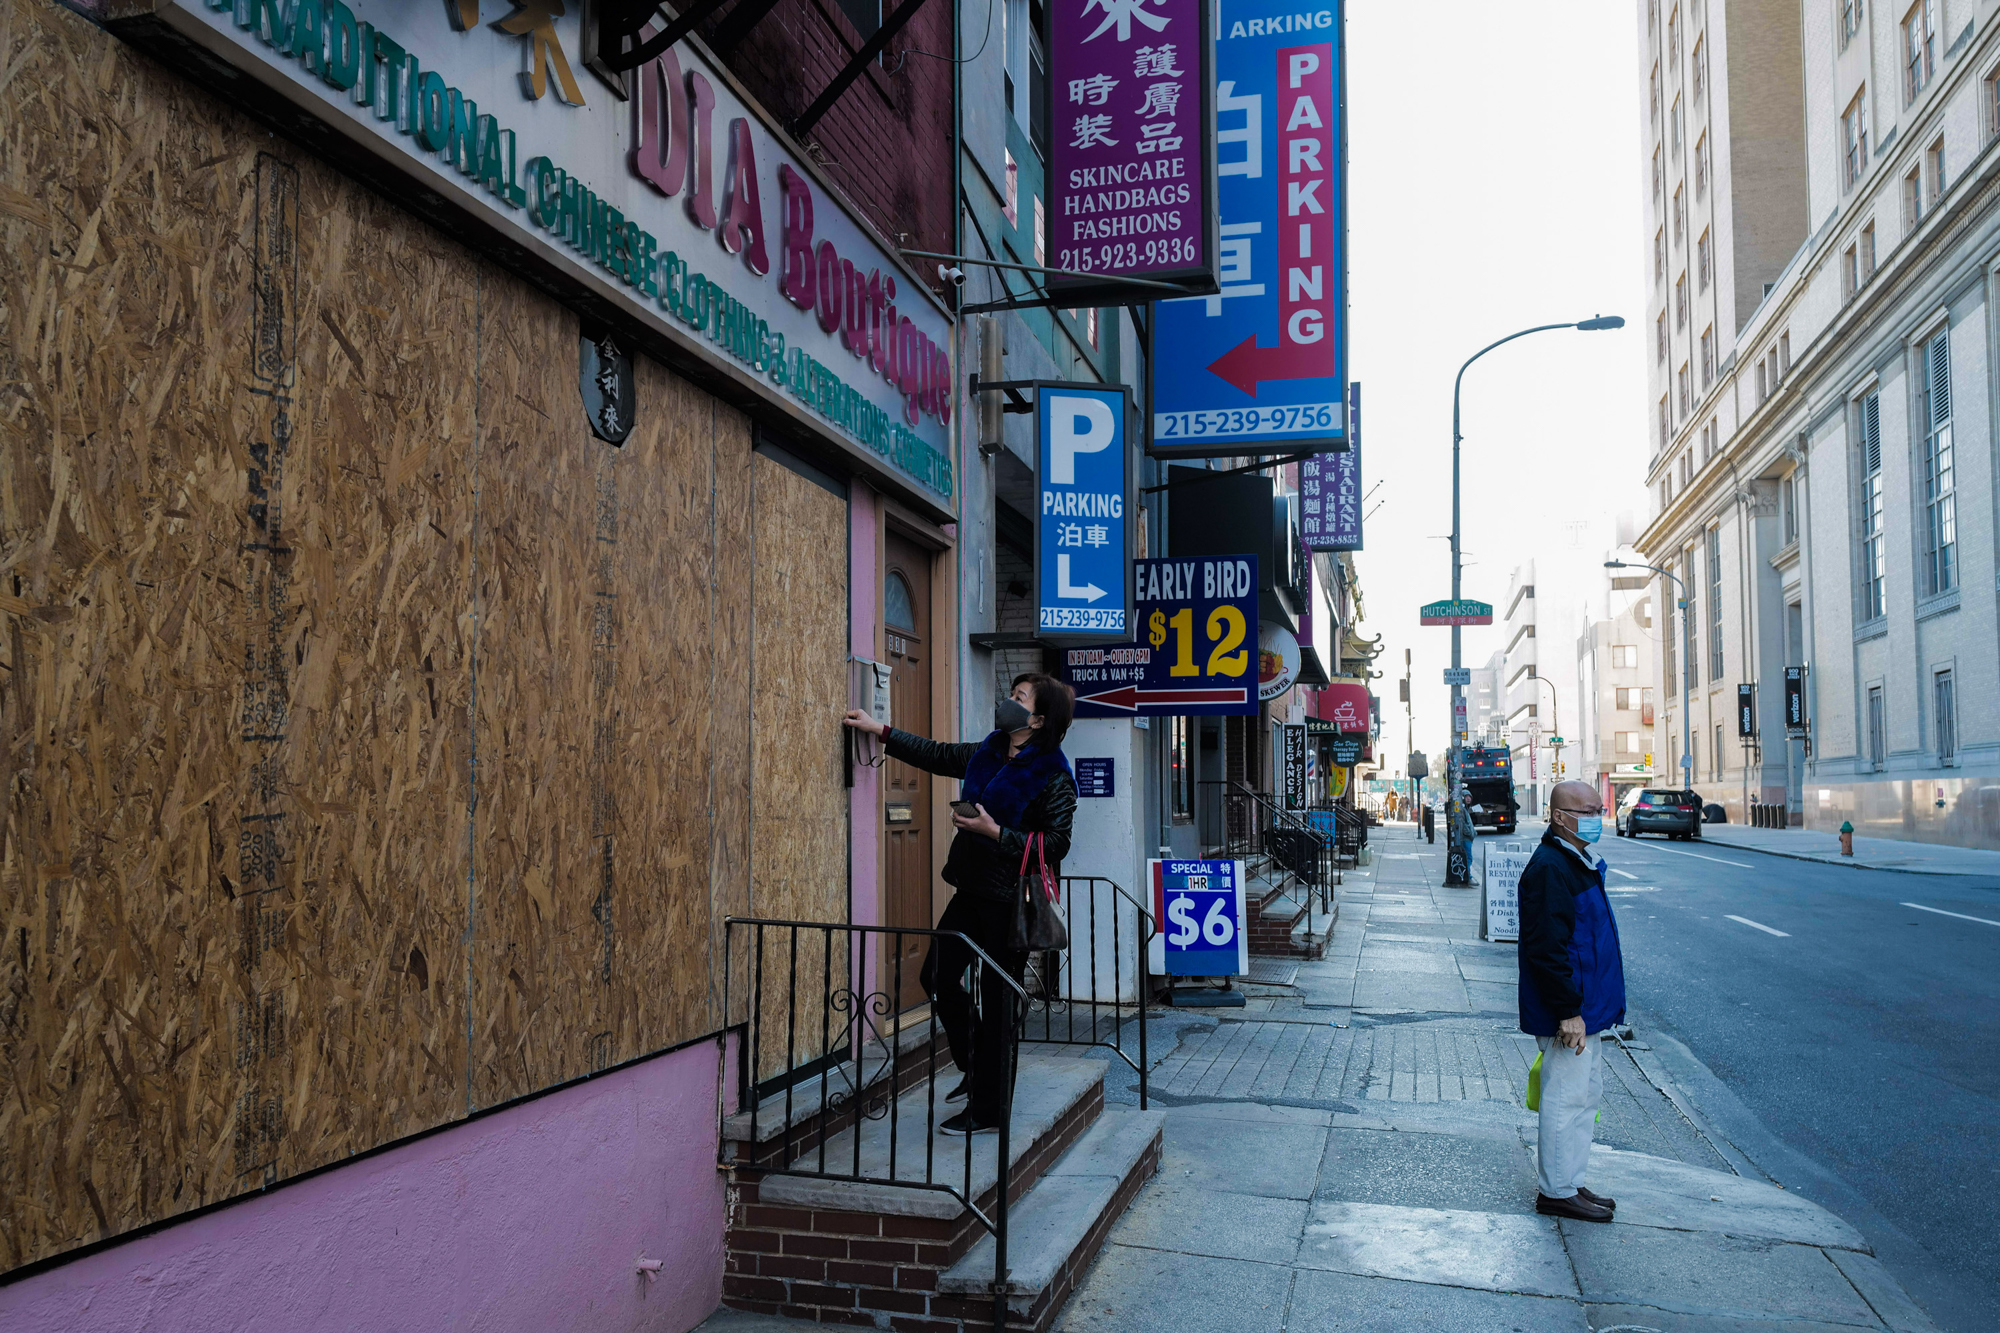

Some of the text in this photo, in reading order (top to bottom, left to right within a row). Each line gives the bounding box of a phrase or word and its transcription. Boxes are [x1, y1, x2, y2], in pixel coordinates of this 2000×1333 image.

[1068, 73, 1120, 150] 時裝
[1133, 43, 1185, 155] 護膚品
[1070, 157, 1185, 189] SKINCARE
[1064, 183, 1190, 215] HANDBAGS
[1286, 53, 1325, 345] PARKING
[204, 0, 526, 210] RADITIONAL
[524, 155, 657, 303] CHINESE
[658, 249, 769, 373] CLOTHING
[786, 346, 889, 455] ALTERATIONS
[630, 24, 770, 279] DIA
[780, 162, 952, 427] Boutique
[1073, 210, 1181, 241] FASHIONS
[1060, 235, 1196, 273] 215-923-9336
[1163, 405, 1332, 437] 215-239-9756
[1050, 395, 1115, 485] P
[1339, 440, 1356, 532] ESTAURANT
[1043, 491, 1123, 519] PARKING
[1056, 522, 1110, 548] 泊車
[1136, 560, 1251, 601] EARLY BIRD
[1041, 608, 1125, 630] 215-239-9756
[1422, 605, 1481, 617] HUTCHINSON
[1068, 650, 1076, 665] IN
[1077, 650, 1086, 665] BY
[1086, 649, 1104, 665] 10AM
[1111, 649, 1125, 664] OUT
[1125, 649, 1135, 664] BY
[1135, 648, 1150, 664] 6PM
[1148, 605, 1249, 678] $12
[1072, 668, 1099, 682] TRUCK
[1101, 669, 1107, 681] &
[1110, 668, 1127, 681] VAN
[1260, 678, 1290, 697] SKEWER
[1791, 693, 1800, 723] verizon
[1286, 729, 1295, 794] ELEGANCE
[1295, 764, 1303, 807] DESIGN
[251, 833, 263, 876] 2020
[1171, 863, 1213, 874] SPECIAL
[1513, 861, 1527, 869] We
[1499, 879, 1518, 887] 四菜
[1168, 892, 1234, 951] $6
[1497, 909, 1514, 917] Dish
